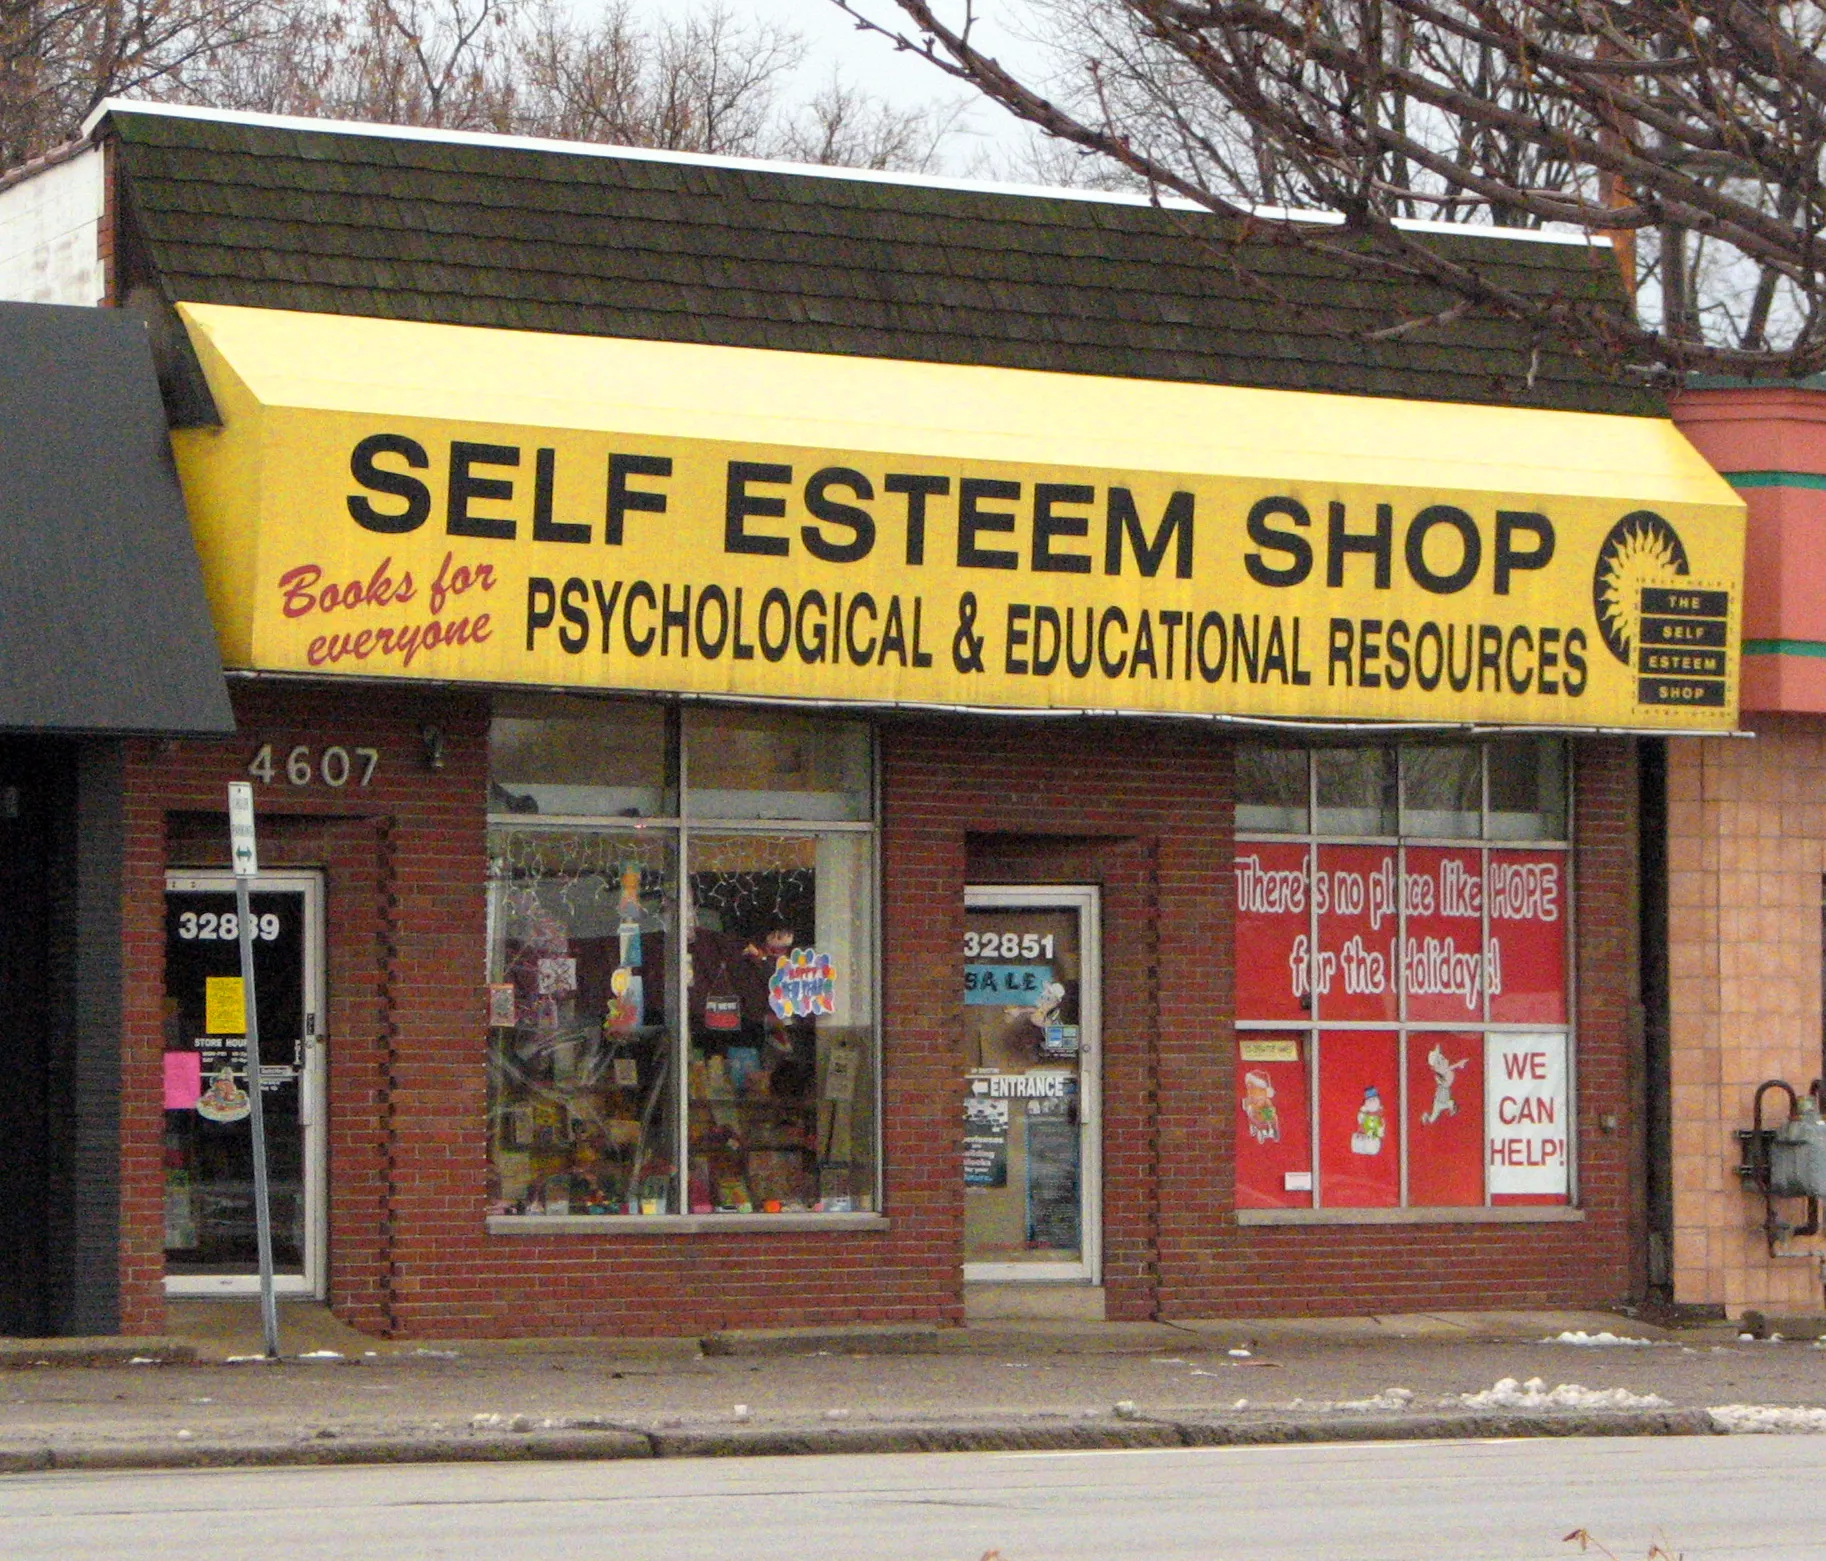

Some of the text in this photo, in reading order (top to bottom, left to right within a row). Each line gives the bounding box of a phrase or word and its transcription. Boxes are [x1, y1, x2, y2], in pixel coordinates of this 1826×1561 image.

[347, 433, 1556, 596] SELF ESTEEM SHOP
[278, 551, 497, 618] Books for
[1667, 594, 1701, 609] THE
[306, 613, 494, 667] everyone
[525, 576, 933, 668] PSYCHOLOGICAL
[952, 591, 985, 674] &
[1005, 603, 1311, 687] EDUCATIONAL
[1328, 617, 1588, 698] RESOURCES
[1662, 625, 1705, 639] SELF
[1648, 655, 1717, 670] ESTEEM
[1658, 685, 1705, 699] SHOP
[248, 743, 379, 787] 4607
[1334, 871, 1364, 914] no
[1370, 857, 1434, 930] plce
[1440, 859, 1483, 917] like
[1489, 863, 1558, 922] HOPE
[963, 932, 1054, 959] 32851
[1341, 935, 1385, 994] the
[965, 971, 1037, 992] SALE
[194, 1037, 222, 1048] STORE
[1503, 1052, 1547, 1080] WE
[990, 1076, 1064, 1097] ENTRANCE
[1499, 1095, 1555, 1125] CAN
[1489, 1138, 1565, 1167] HELP!
